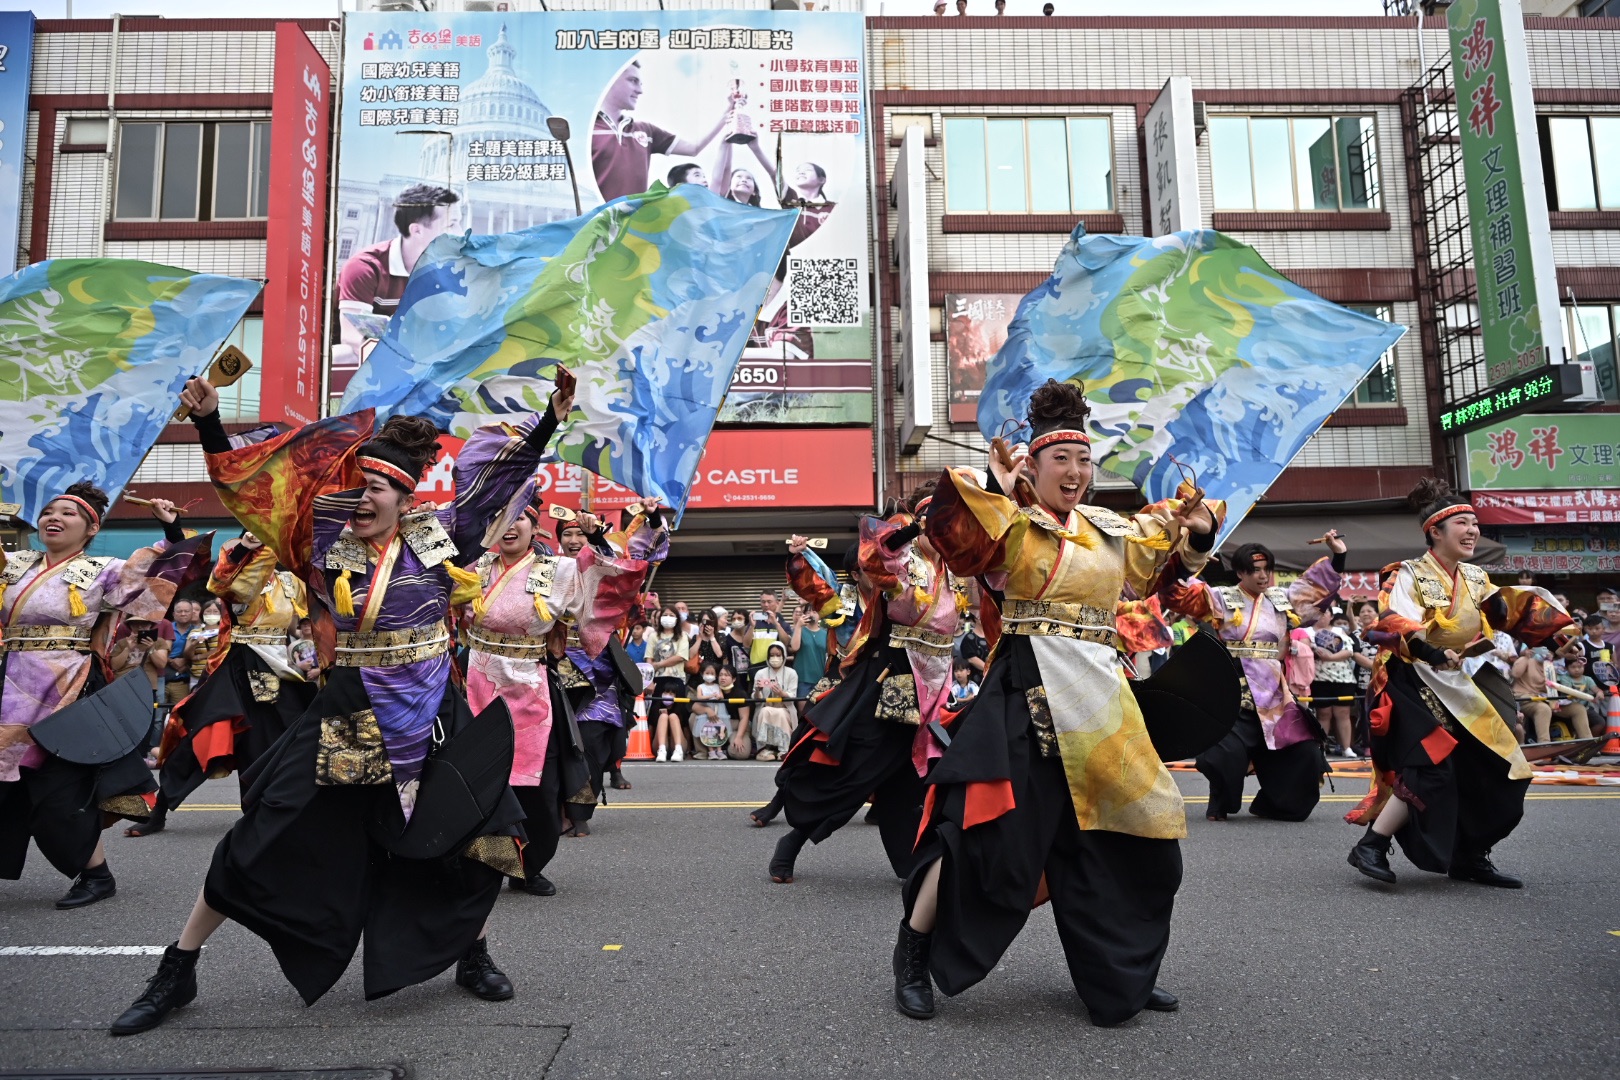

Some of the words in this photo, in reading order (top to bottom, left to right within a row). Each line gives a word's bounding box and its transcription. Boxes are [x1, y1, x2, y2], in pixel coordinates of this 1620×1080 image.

[456, 35, 481, 47] 美語
[556, 29, 660, 50] 加入吉的堡
[669, 29, 793, 50] 迎向勝利曙光
[362, 61, 460, 79] 國際幼兒美語
[770, 59, 859, 73] 小學教育專班
[361, 85, 459, 103] 幼小銜接美語
[770, 79, 860, 93] 國小數學專班
[770, 99, 860, 114] 進階數學專班
[359, 108, 459, 126] 國際兒童美語
[770, 119, 860, 134] 各項營隊活動
[469, 140, 566, 157] 主題美語課程
[467, 163, 566, 181] 美語分級課程
[1481, 145, 1522, 321] 文理補習班
[300, 259, 310, 300] KID
[296, 305, 308, 398] CASTLE
[1487, 426, 1563, 471] 鴻祥
[707, 468, 798, 485] CASTLE
